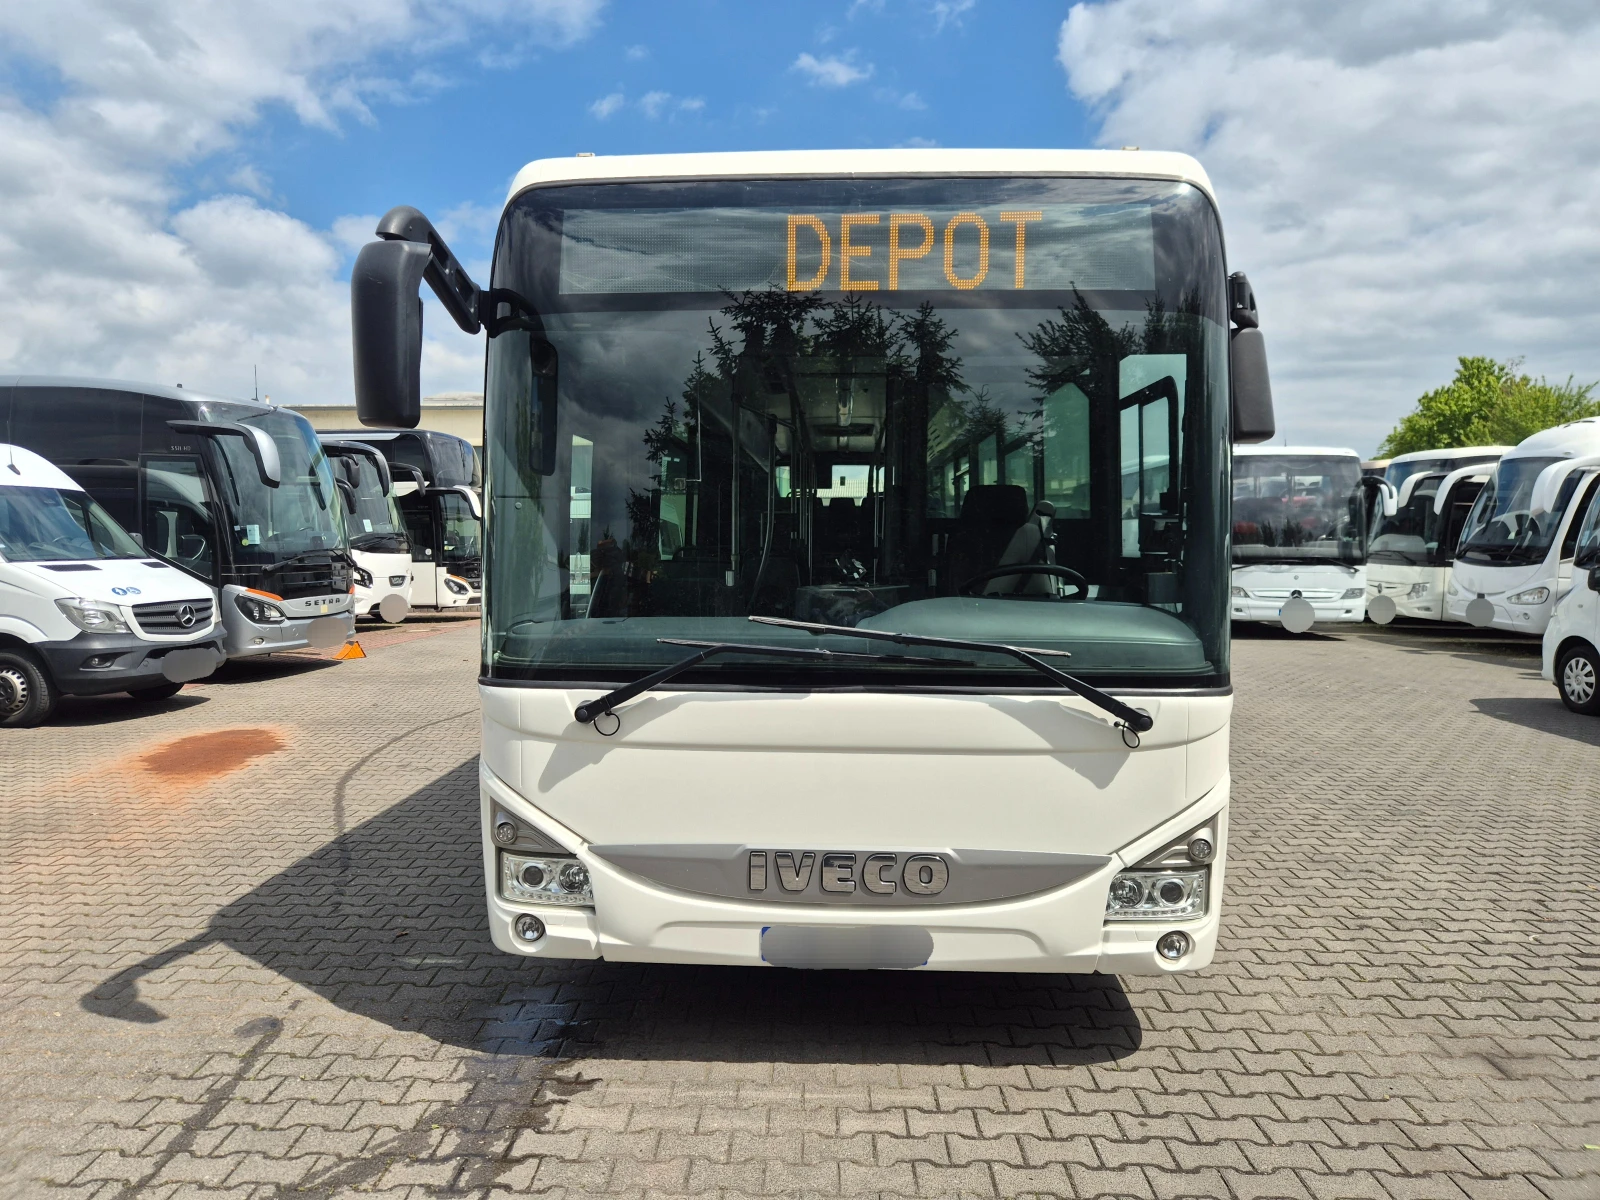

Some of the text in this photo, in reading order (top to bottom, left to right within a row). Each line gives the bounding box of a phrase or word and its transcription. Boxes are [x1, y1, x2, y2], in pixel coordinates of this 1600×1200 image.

[787, 211, 1042, 291] DEPOT
[305, 598, 340, 606] SETRA
[750, 851, 949, 895] IVECO
